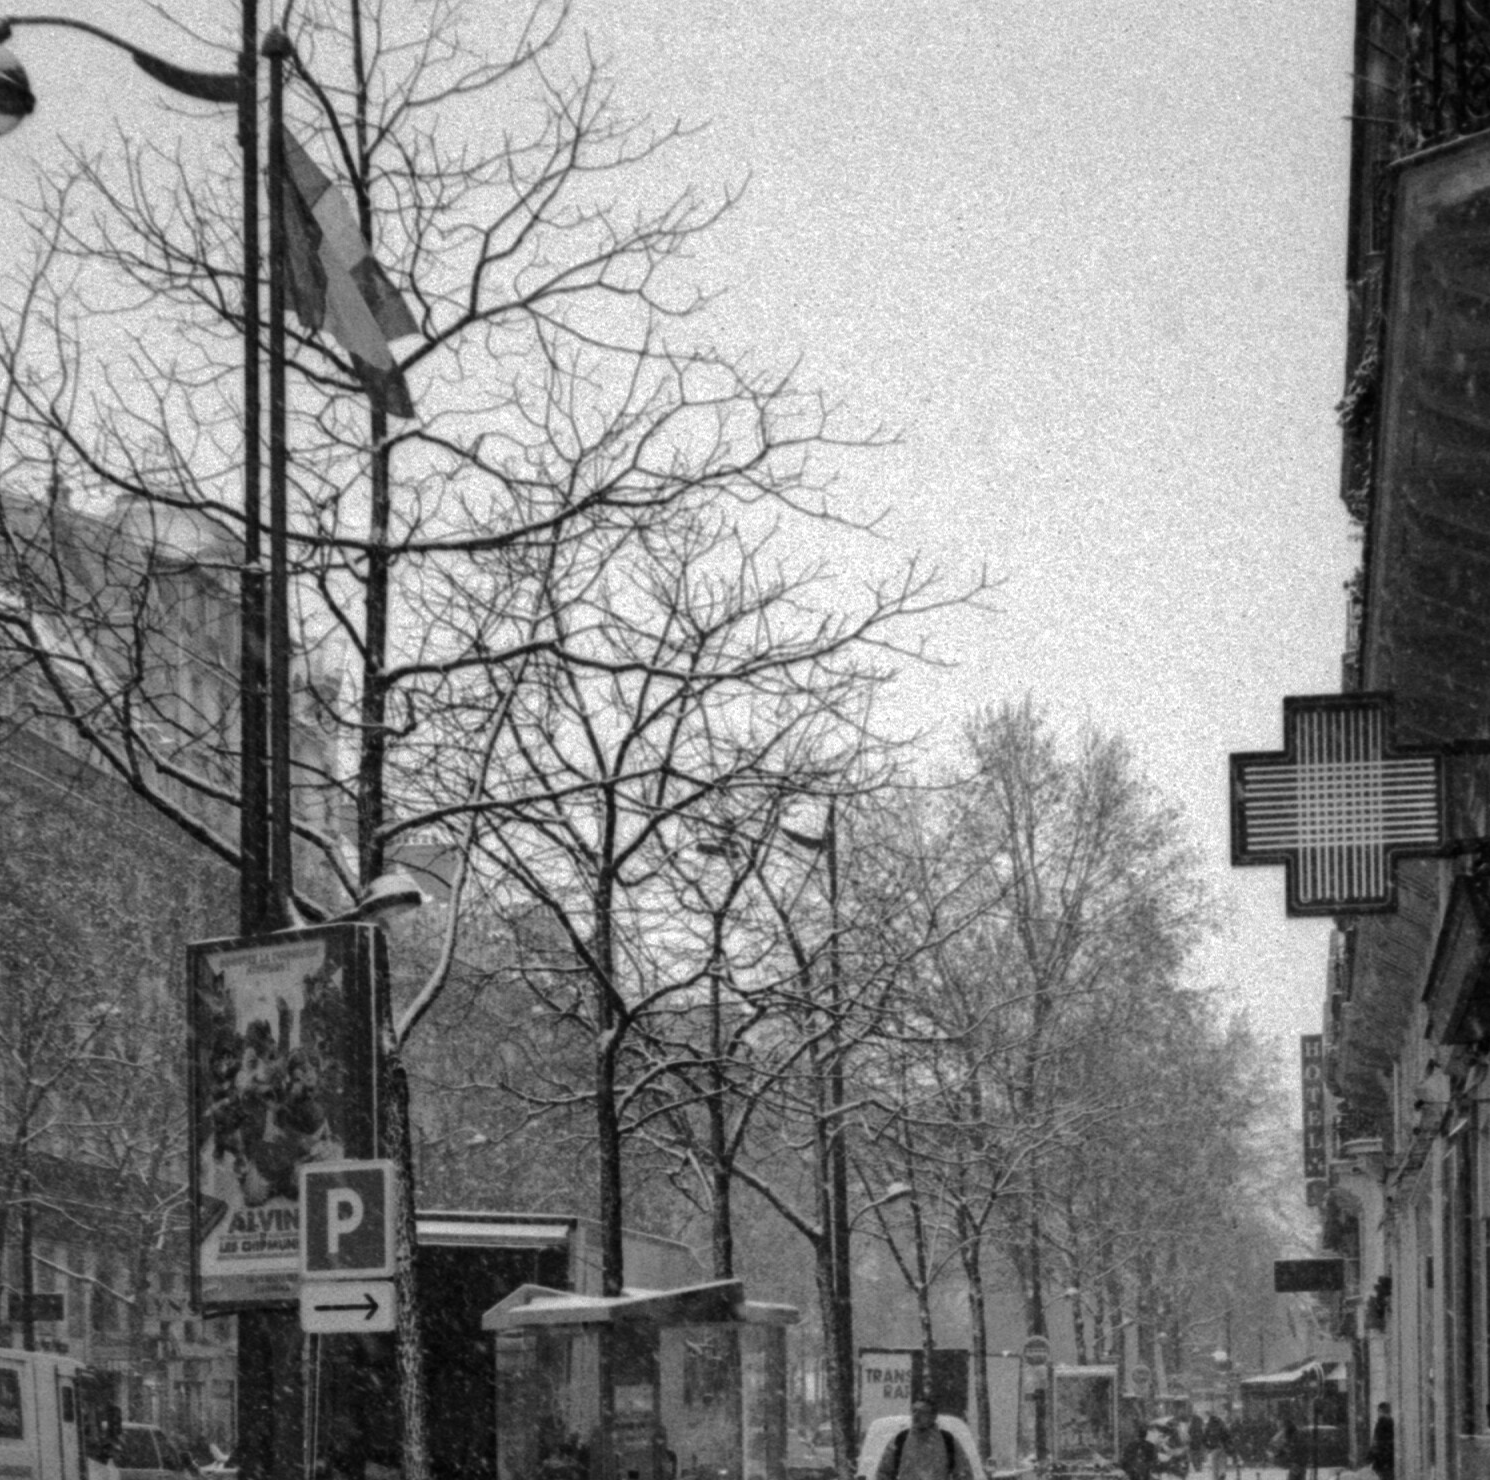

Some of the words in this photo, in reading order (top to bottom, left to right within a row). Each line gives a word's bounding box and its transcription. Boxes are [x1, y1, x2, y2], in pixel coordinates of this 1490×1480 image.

[1304, 1041, 1323, 1150] HOTEL
[227, 1208, 300, 1235] ALVIN
[326, 1186, 365, 1254] P
